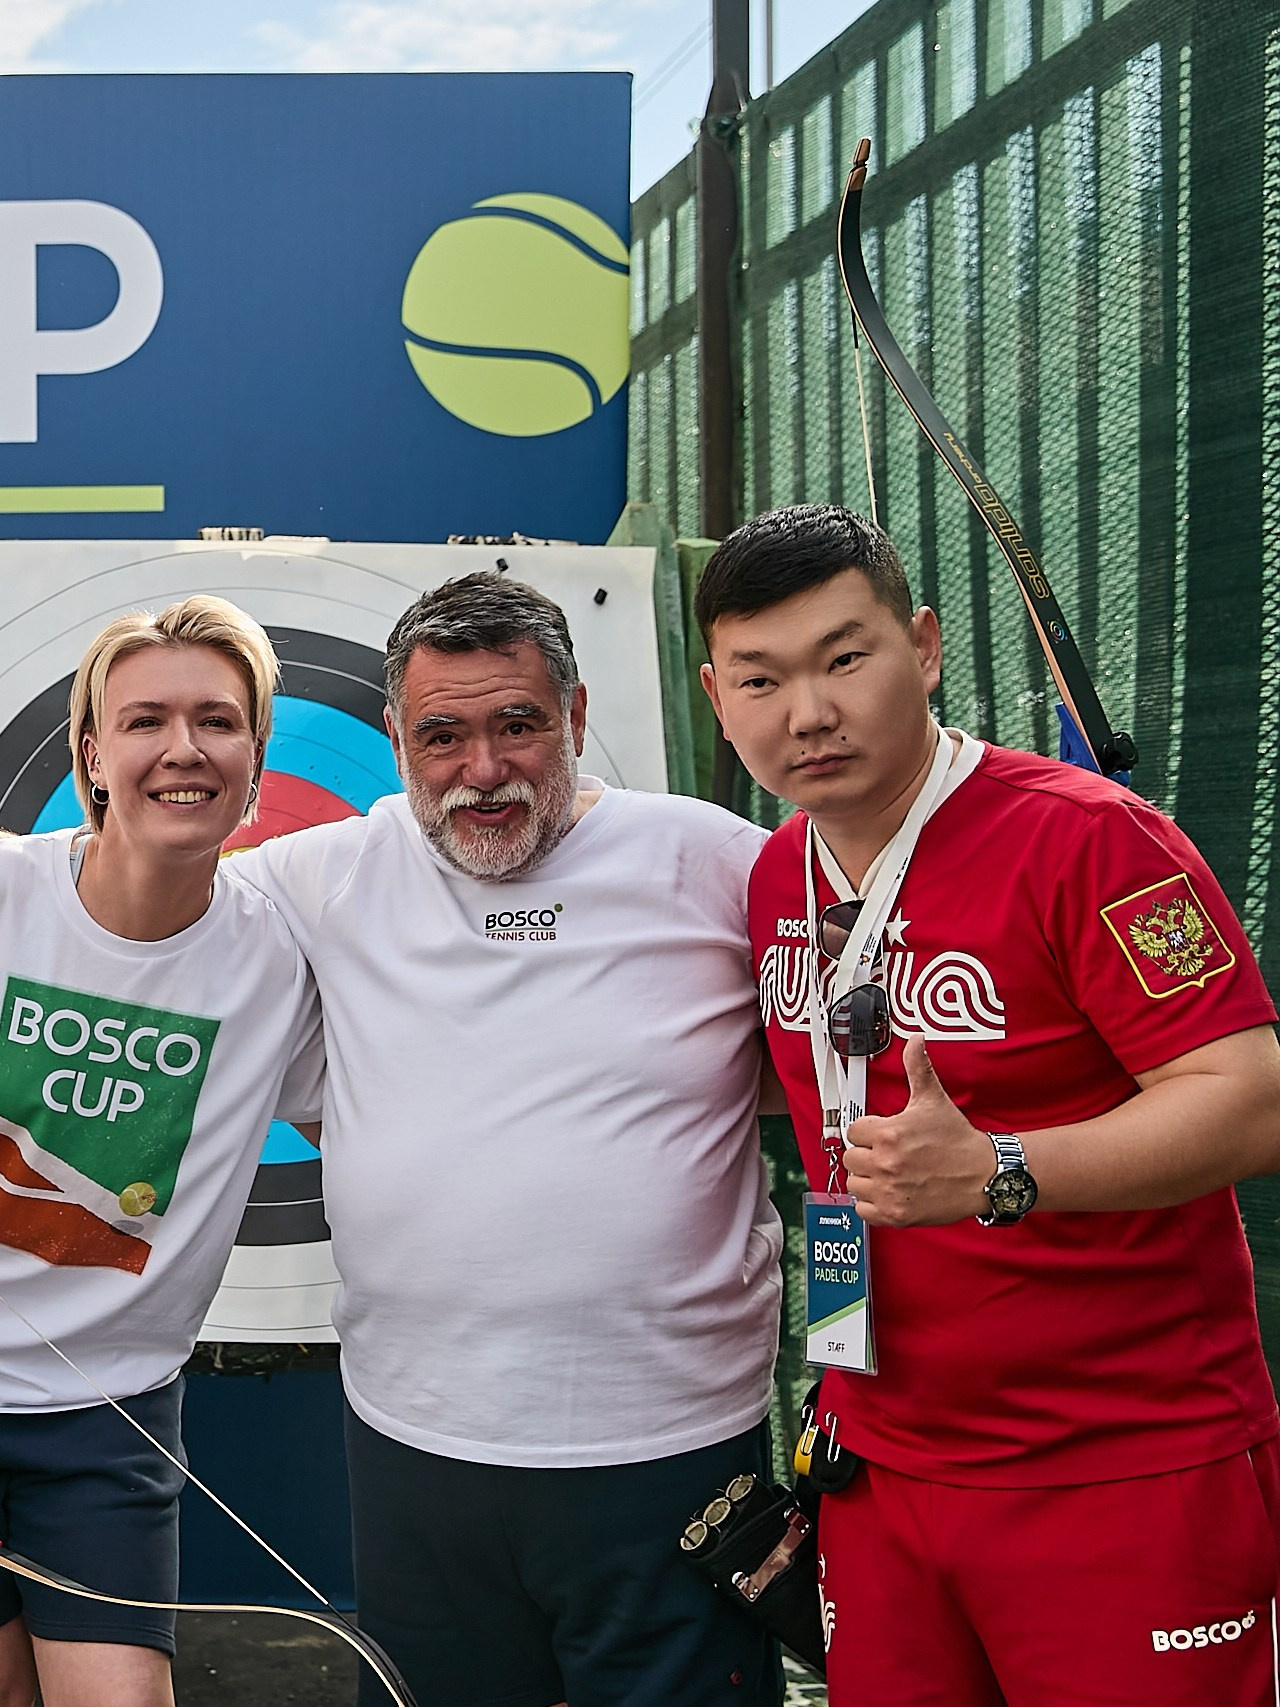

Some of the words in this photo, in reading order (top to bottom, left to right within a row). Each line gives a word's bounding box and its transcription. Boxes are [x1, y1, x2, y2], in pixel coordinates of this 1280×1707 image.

[942, 432, 983, 484] archery
[485, 909, 556, 930] BOSCO
[777, 918, 818, 938] BOSC
[485, 931, 525, 941] TENNIS
[528, 931, 557, 941] CLUB
[7, 996, 201, 1077] BOSCO
[42, 1069, 145, 1122] CUP
[814, 1240, 859, 1265] BOSCO
[815, 1267, 840, 1283] PADEL
[842, 1271, 859, 1284] CUP
[827, 1341, 846, 1353] STAFF
[1151, 1620, 1242, 1652] BOSCO
